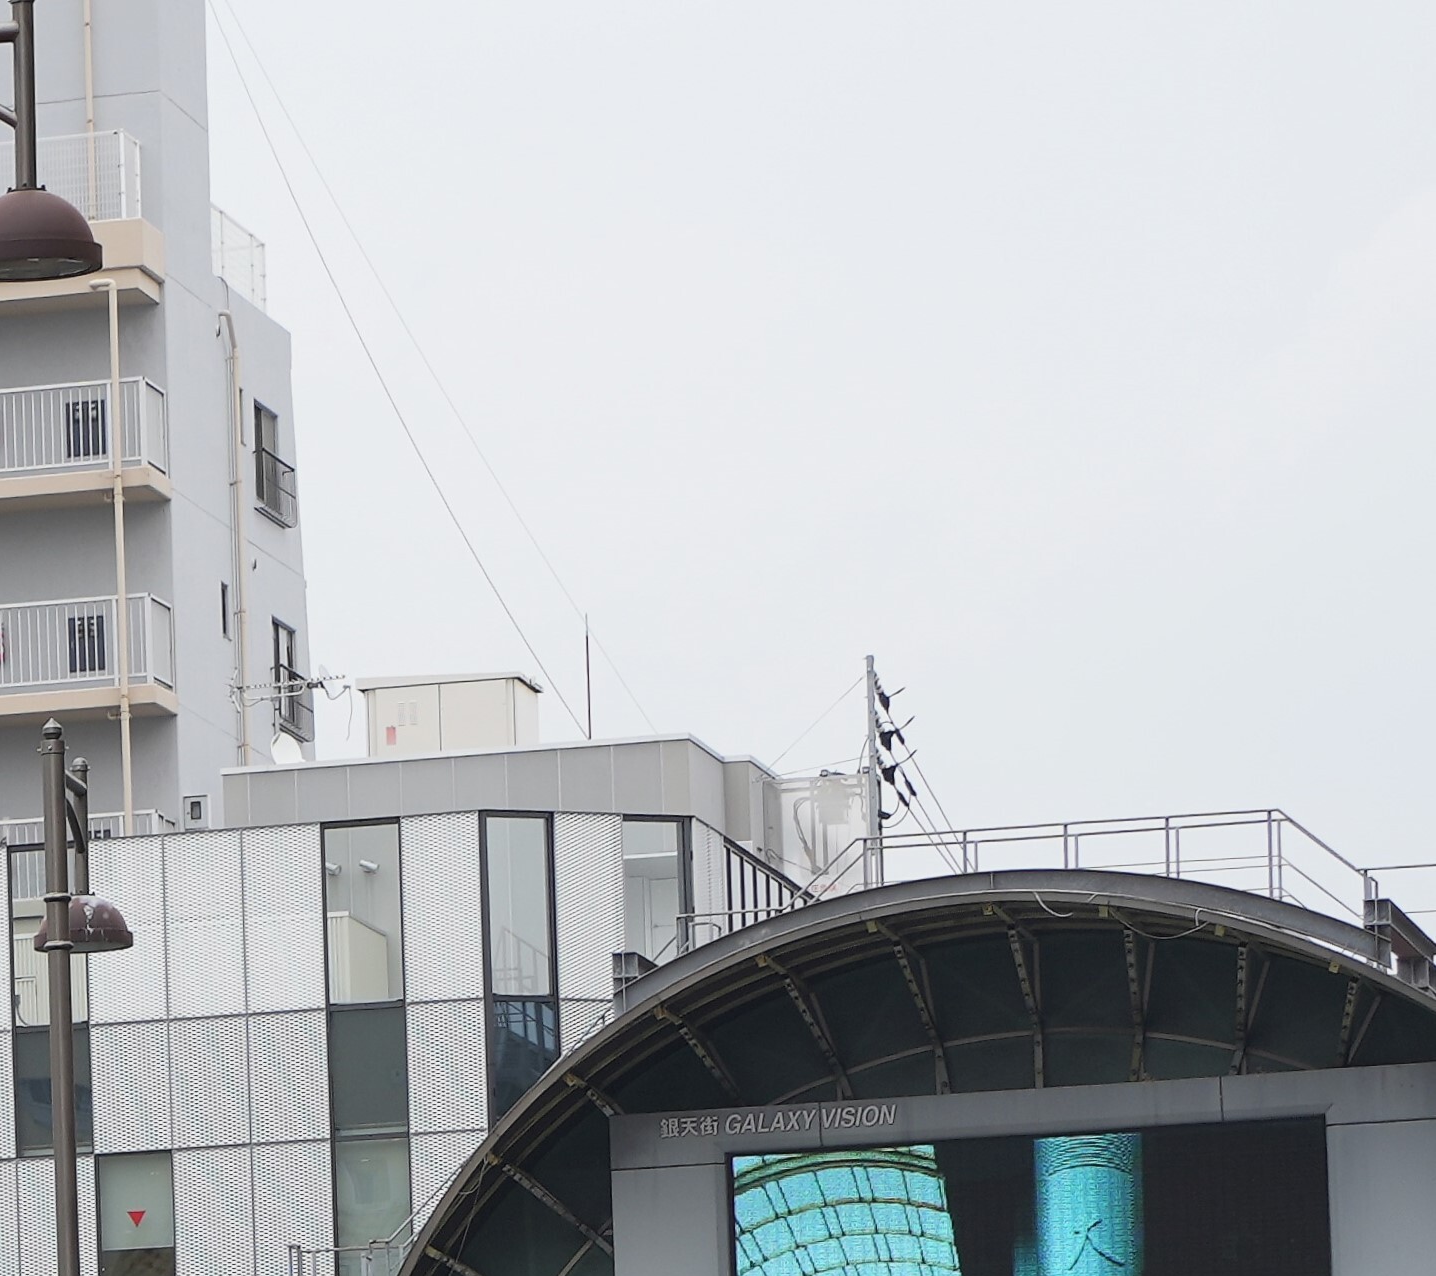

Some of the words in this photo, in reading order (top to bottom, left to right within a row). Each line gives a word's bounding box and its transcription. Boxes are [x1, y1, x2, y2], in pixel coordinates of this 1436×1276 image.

[660, 1116, 719, 1139] 銀天街
[724, 1109, 818, 1136] GALAXY
[821, 1104, 897, 1130] VISION
